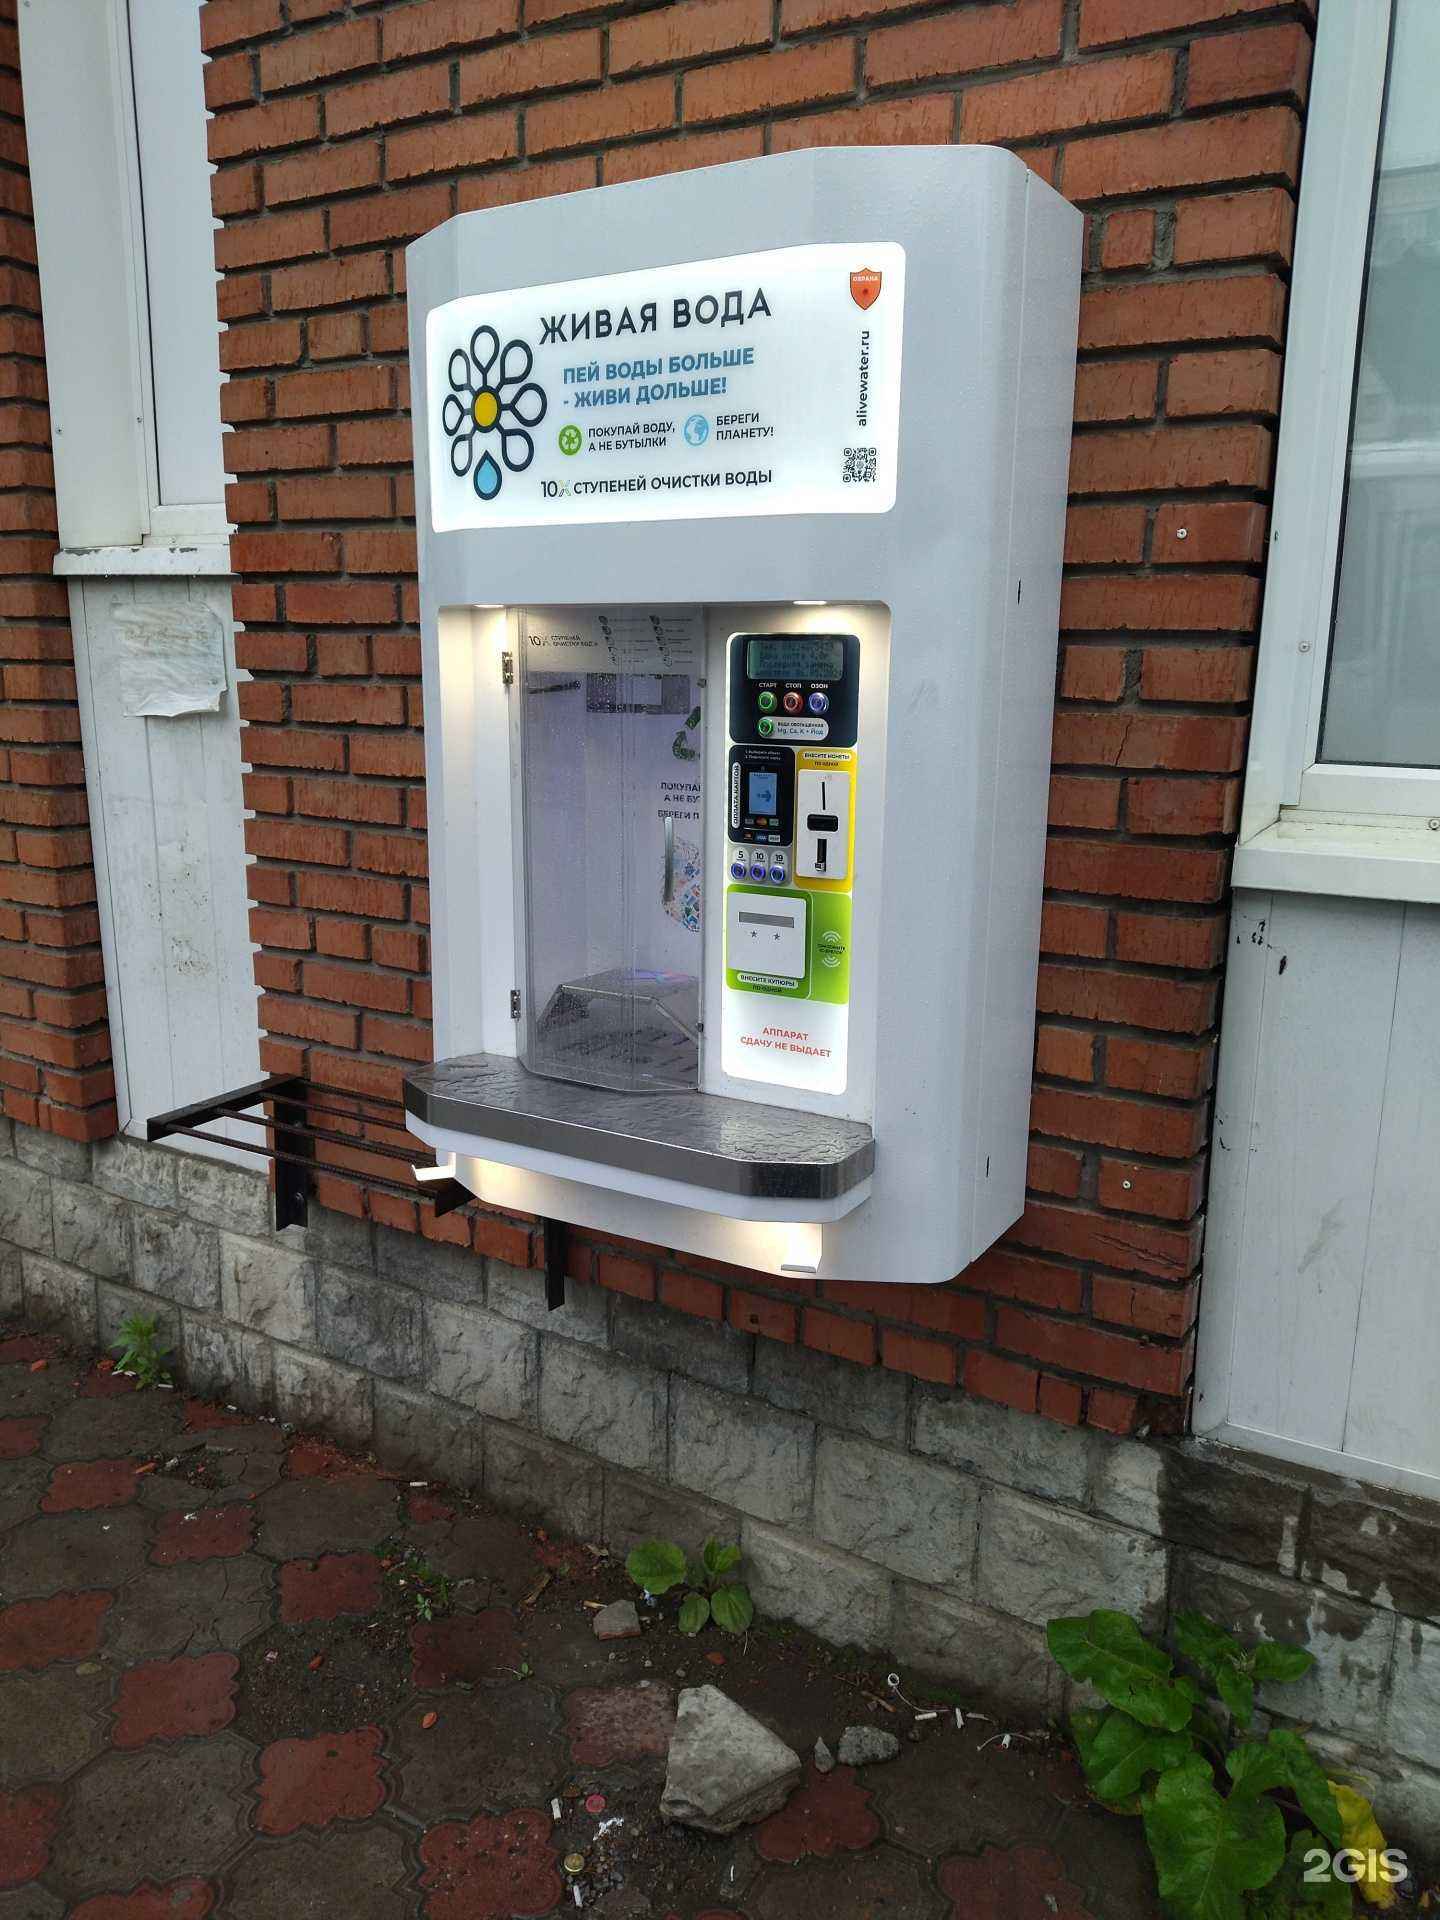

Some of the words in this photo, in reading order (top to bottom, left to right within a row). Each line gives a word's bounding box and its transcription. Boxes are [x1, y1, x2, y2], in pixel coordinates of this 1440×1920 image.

[539, 302, 657, 345] ЖИВАЯ
[673, 288, 772, 328] ВОДА
[563, 361, 600, 384] ПЕЙ
[605, 358, 663, 381] ВОДЫ
[668, 347, 755, 373] БОЛЬШЕ
[856, 331, 870, 427] alivewater.ru
[574, 386, 631, 408] ЖИВИ
[636, 377, 727, 405] ДОЛЬШЕ!
[716, 413, 760, 426] БЕРЕГИ
[588, 422, 641, 438] ПОКУПАЙ
[643, 421, 676, 434] ВОДУ,
[716, 426, 774, 441] ПЛАНЕТУ!
[588, 442, 597, 452] А
[599, 441, 613, 451] НЕ
[615, 436, 667, 450] БУТЫЛКИ
[573, 475, 647, 495] СТУПЕНЕЙ
[651, 472, 721, 490] ОЧИСТКИ
[725, 469, 772, 486] ВОДЫ
[738, 850, 744, 859] 5
[755, 852, 764, 860] 10
[767, 977, 795, 987] КУПЮРЫ
[762, 1027, 809, 1041] АППАРАТ
[740, 1036, 772, 1049] СДАЧУ
[774, 1041, 788, 1051] НЕ
[789, 1043, 832, 1058] ВЫДАЕТ
